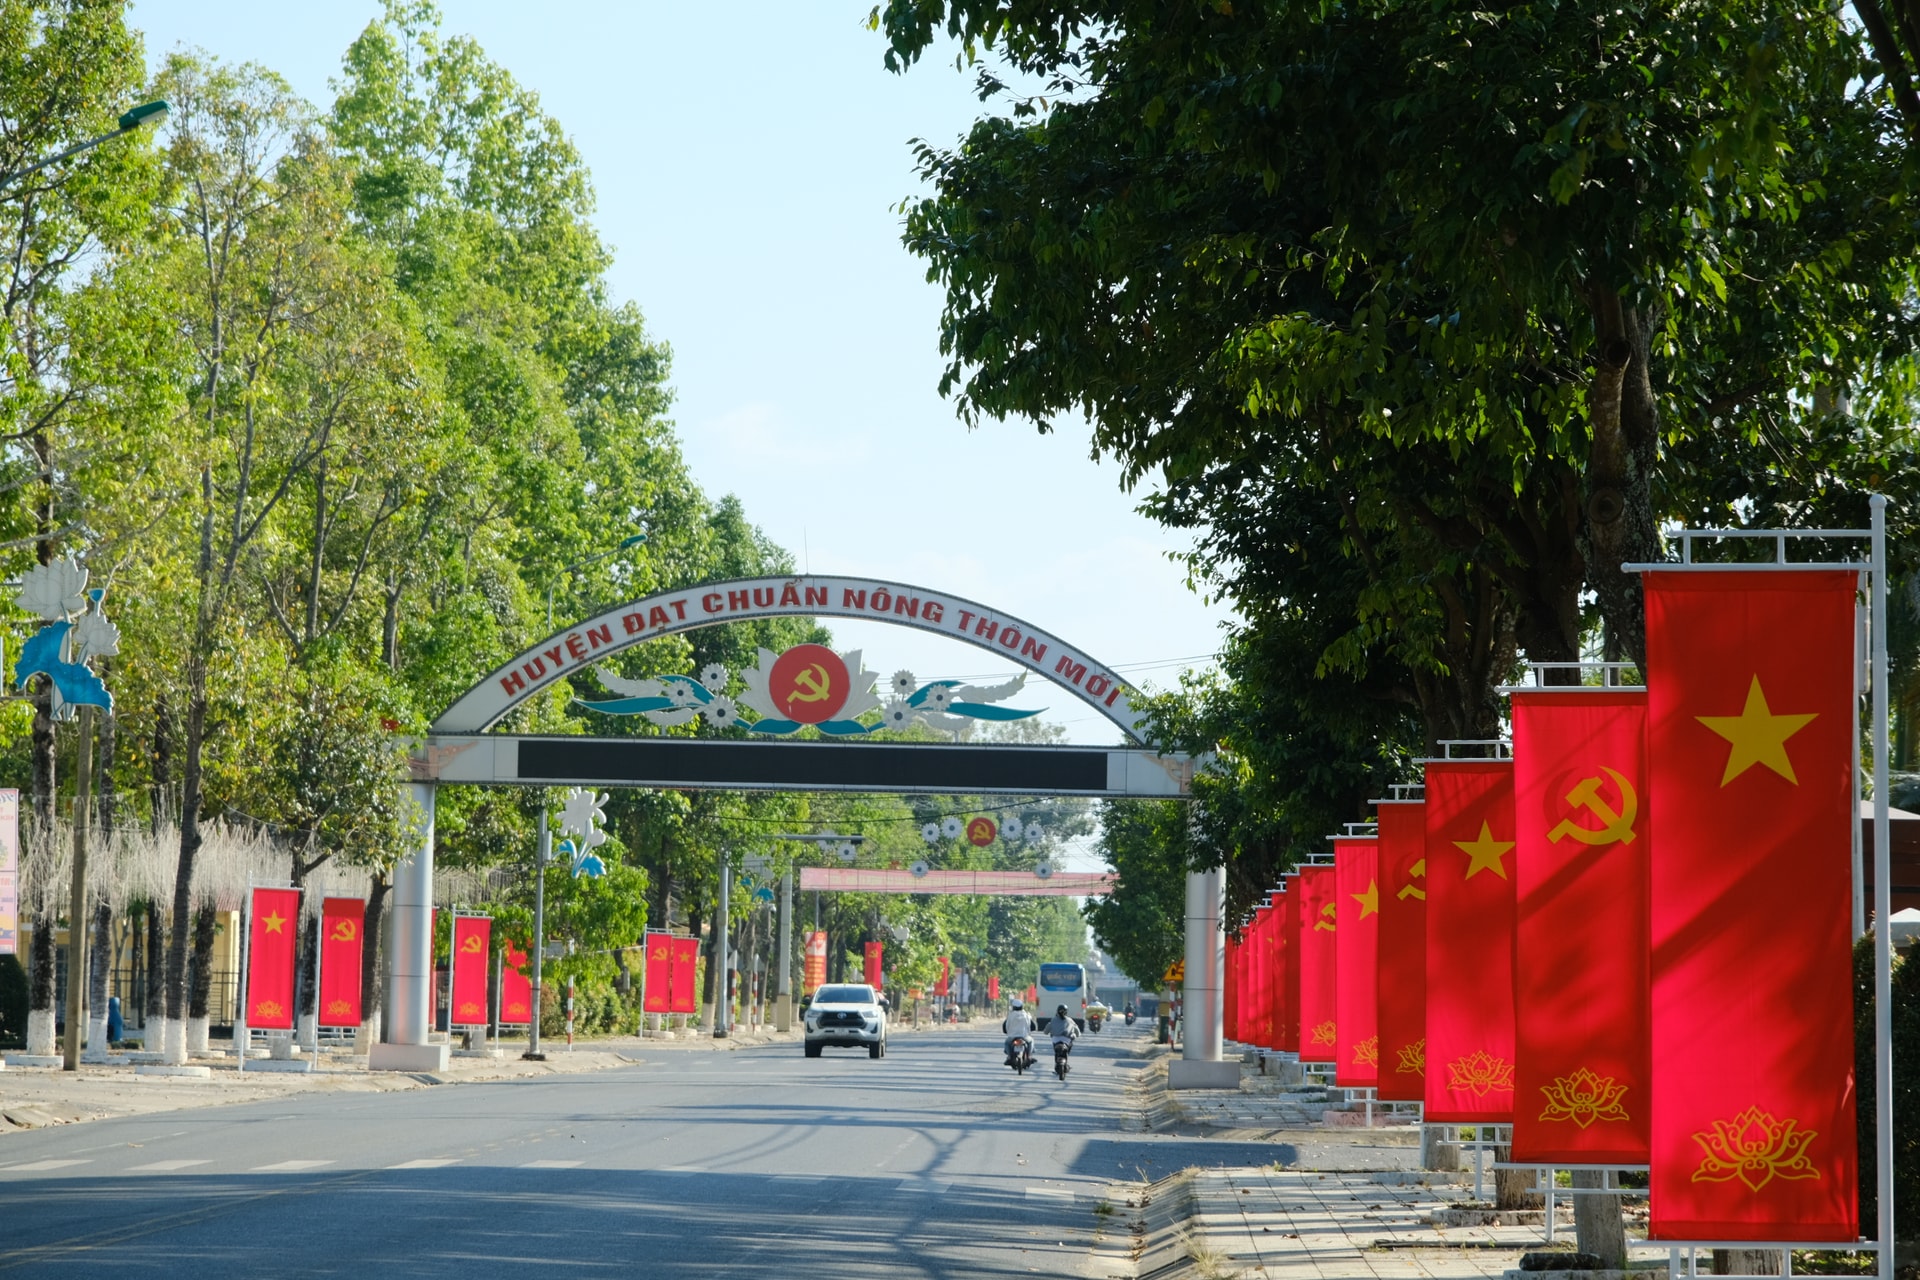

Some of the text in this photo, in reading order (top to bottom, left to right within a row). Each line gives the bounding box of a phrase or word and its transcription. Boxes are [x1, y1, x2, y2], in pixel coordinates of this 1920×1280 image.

[500, 577, 1122, 708] HUYỆN ĐẠT CHUẨN NÔNG THÔN MỚI
